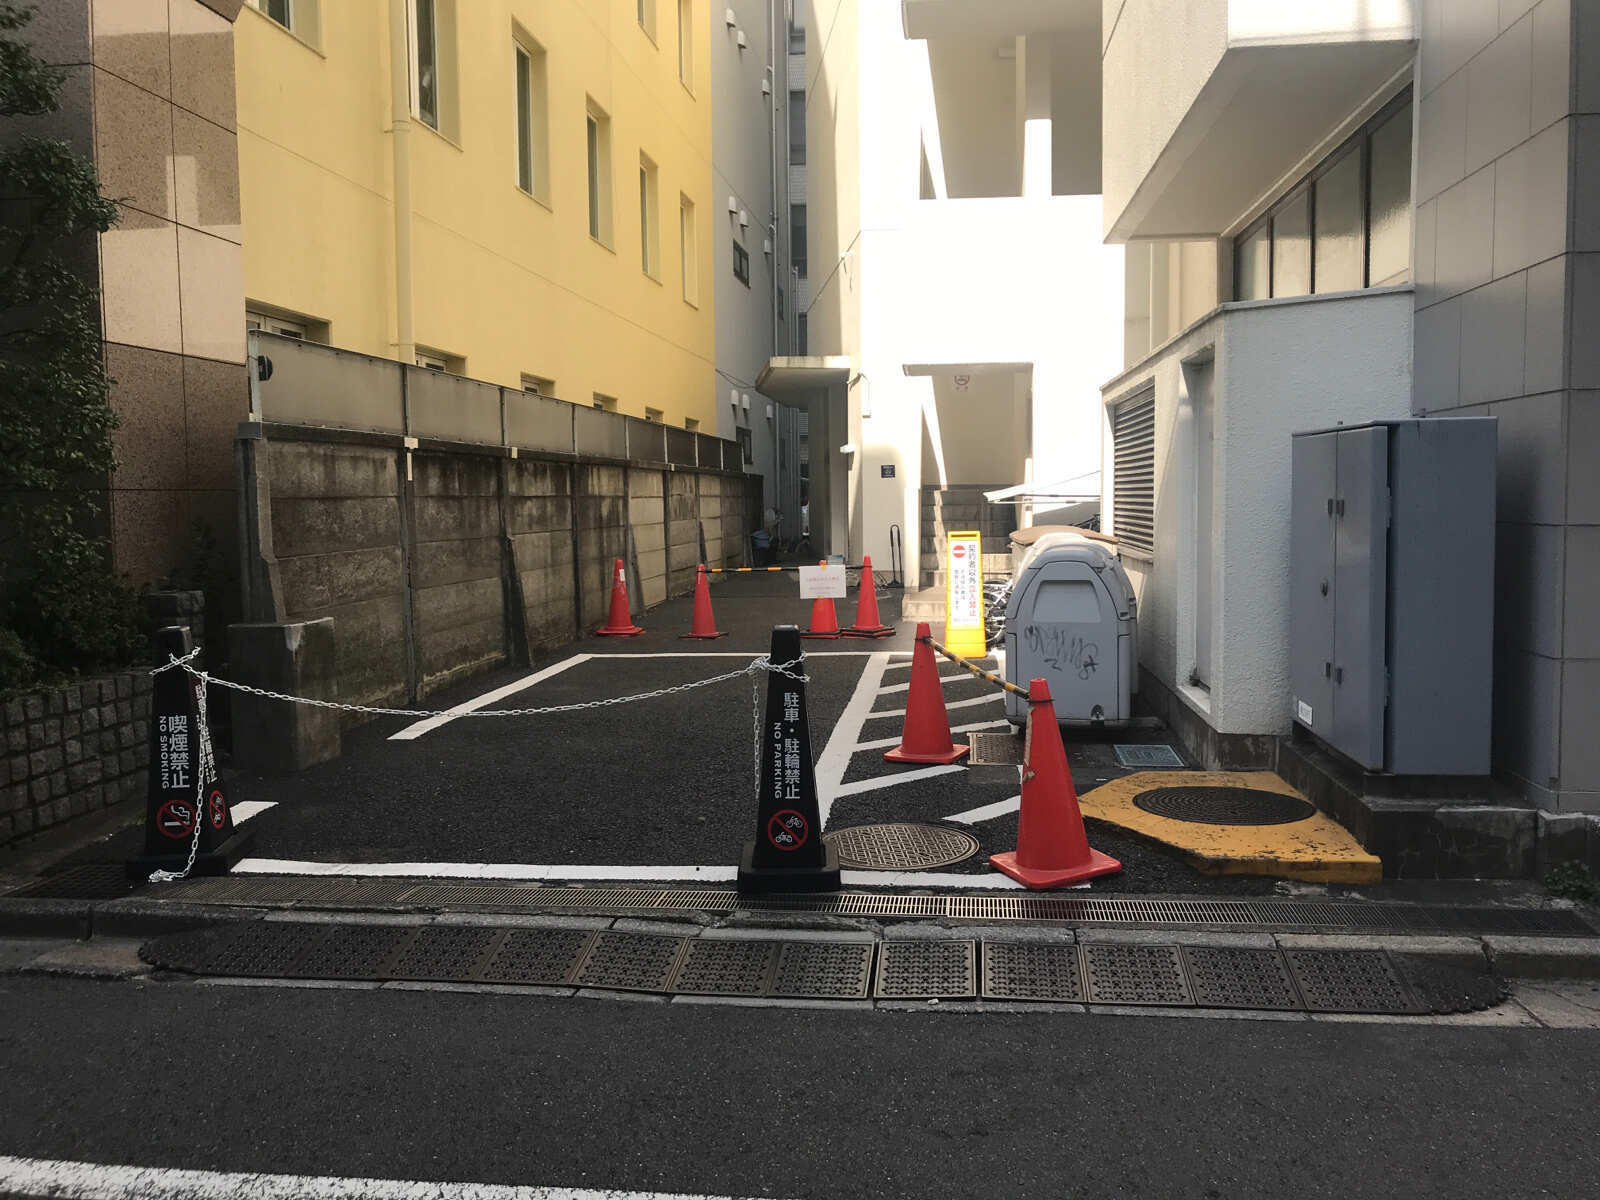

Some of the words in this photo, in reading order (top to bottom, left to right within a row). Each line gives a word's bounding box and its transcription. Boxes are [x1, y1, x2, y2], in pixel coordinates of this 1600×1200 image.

[160, 715, 167, 732] NO
[168, 714, 190, 788] 喫煙禁止
[774, 722, 782, 740] NO
[784, 692, 800, 799] 駐車・駐輪禁止
[160, 735, 169, 789] SMOKING
[774, 743, 782, 799] PARKING
